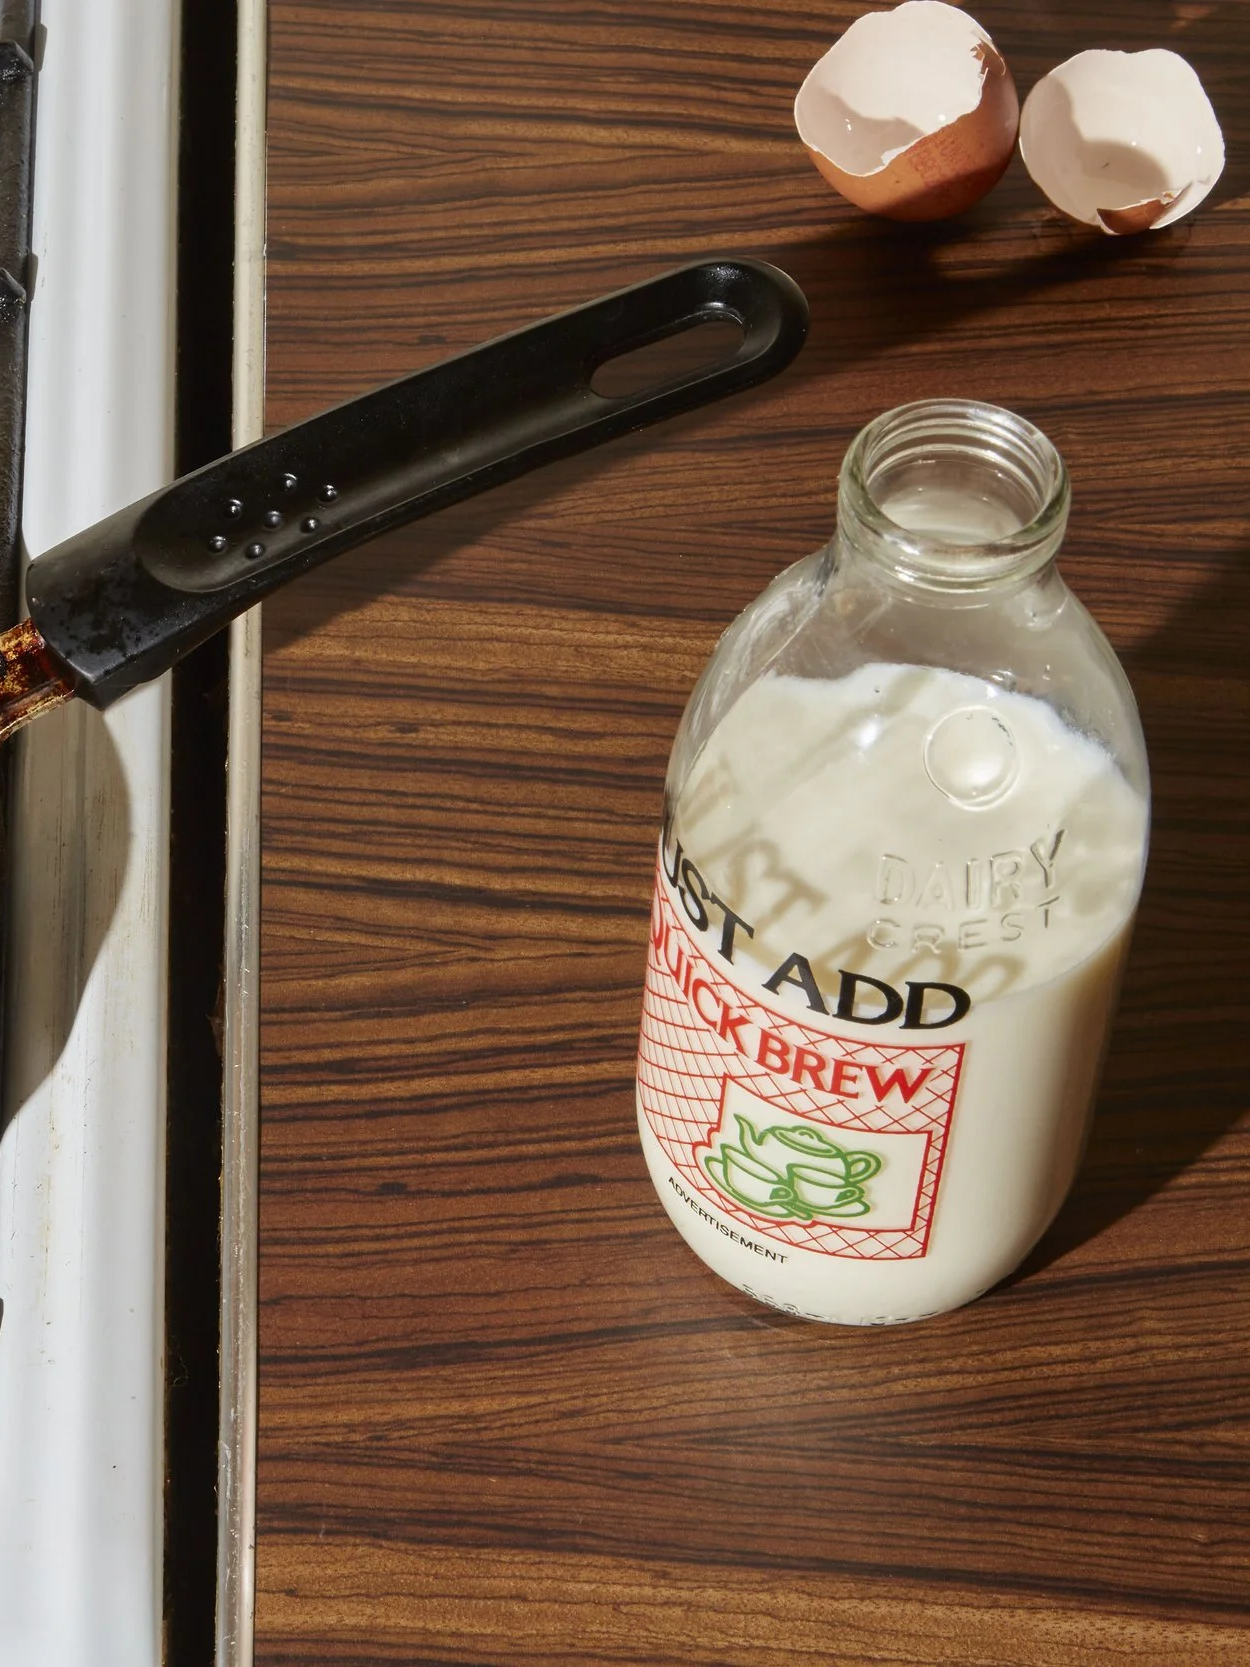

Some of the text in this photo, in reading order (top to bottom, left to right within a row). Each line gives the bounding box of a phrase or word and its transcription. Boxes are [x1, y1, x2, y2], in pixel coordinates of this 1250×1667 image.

[872, 828, 1066, 911] DAIRY
[662, 806, 972, 1030] UST ADD
[866, 895, 1060, 954] CREST
[754, 1026, 936, 1104] BREW
[668, 1176, 788, 1264] ADVERTISEMENT
